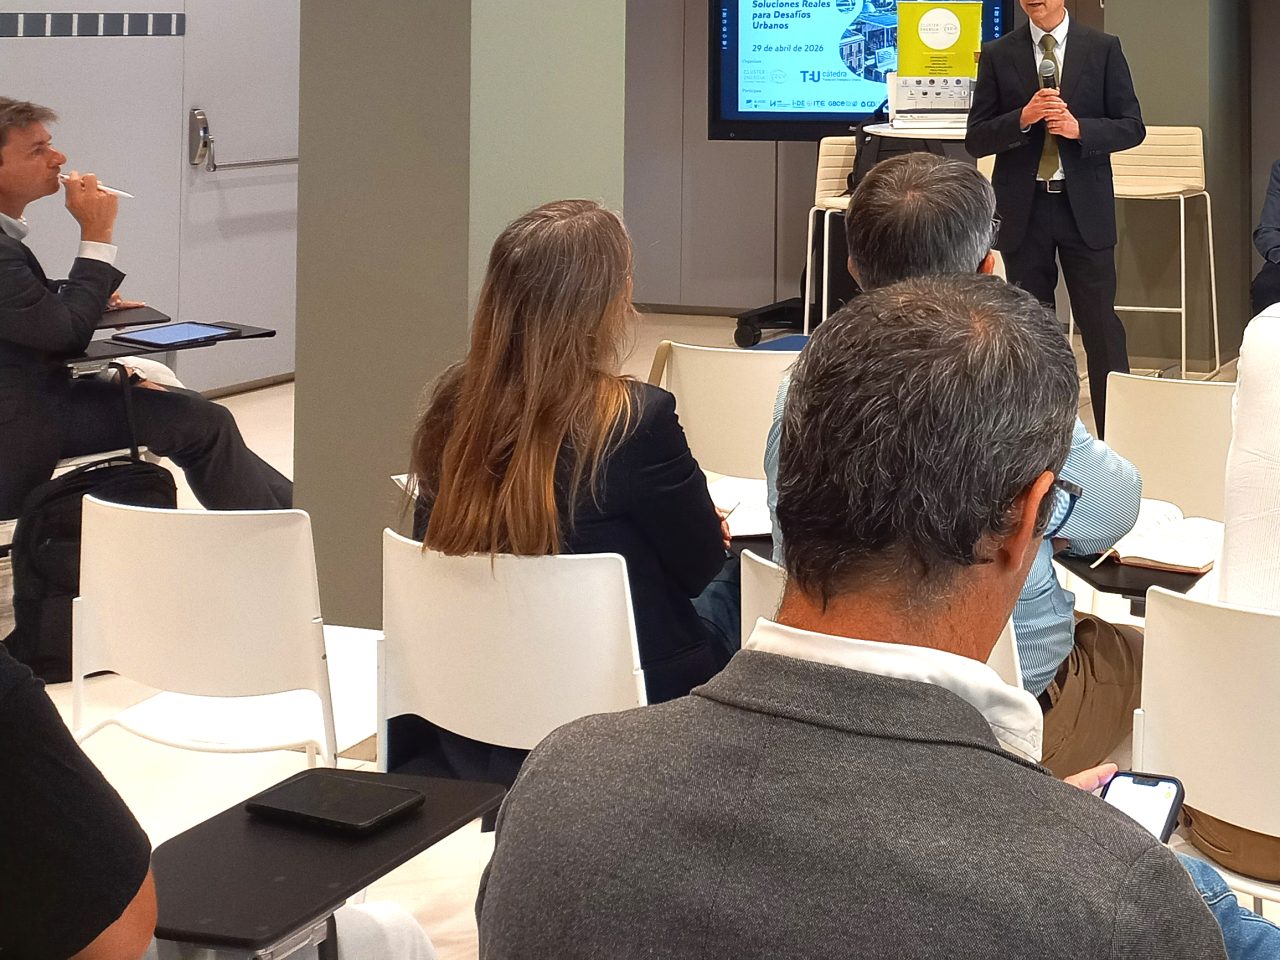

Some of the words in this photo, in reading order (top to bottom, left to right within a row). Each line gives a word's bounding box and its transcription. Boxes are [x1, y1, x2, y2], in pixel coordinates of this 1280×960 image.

[753, 0, 799, 8] Soluciones
[774, 10, 810, 18] Desafíos
[753, 21, 788, 29] Urbanos
